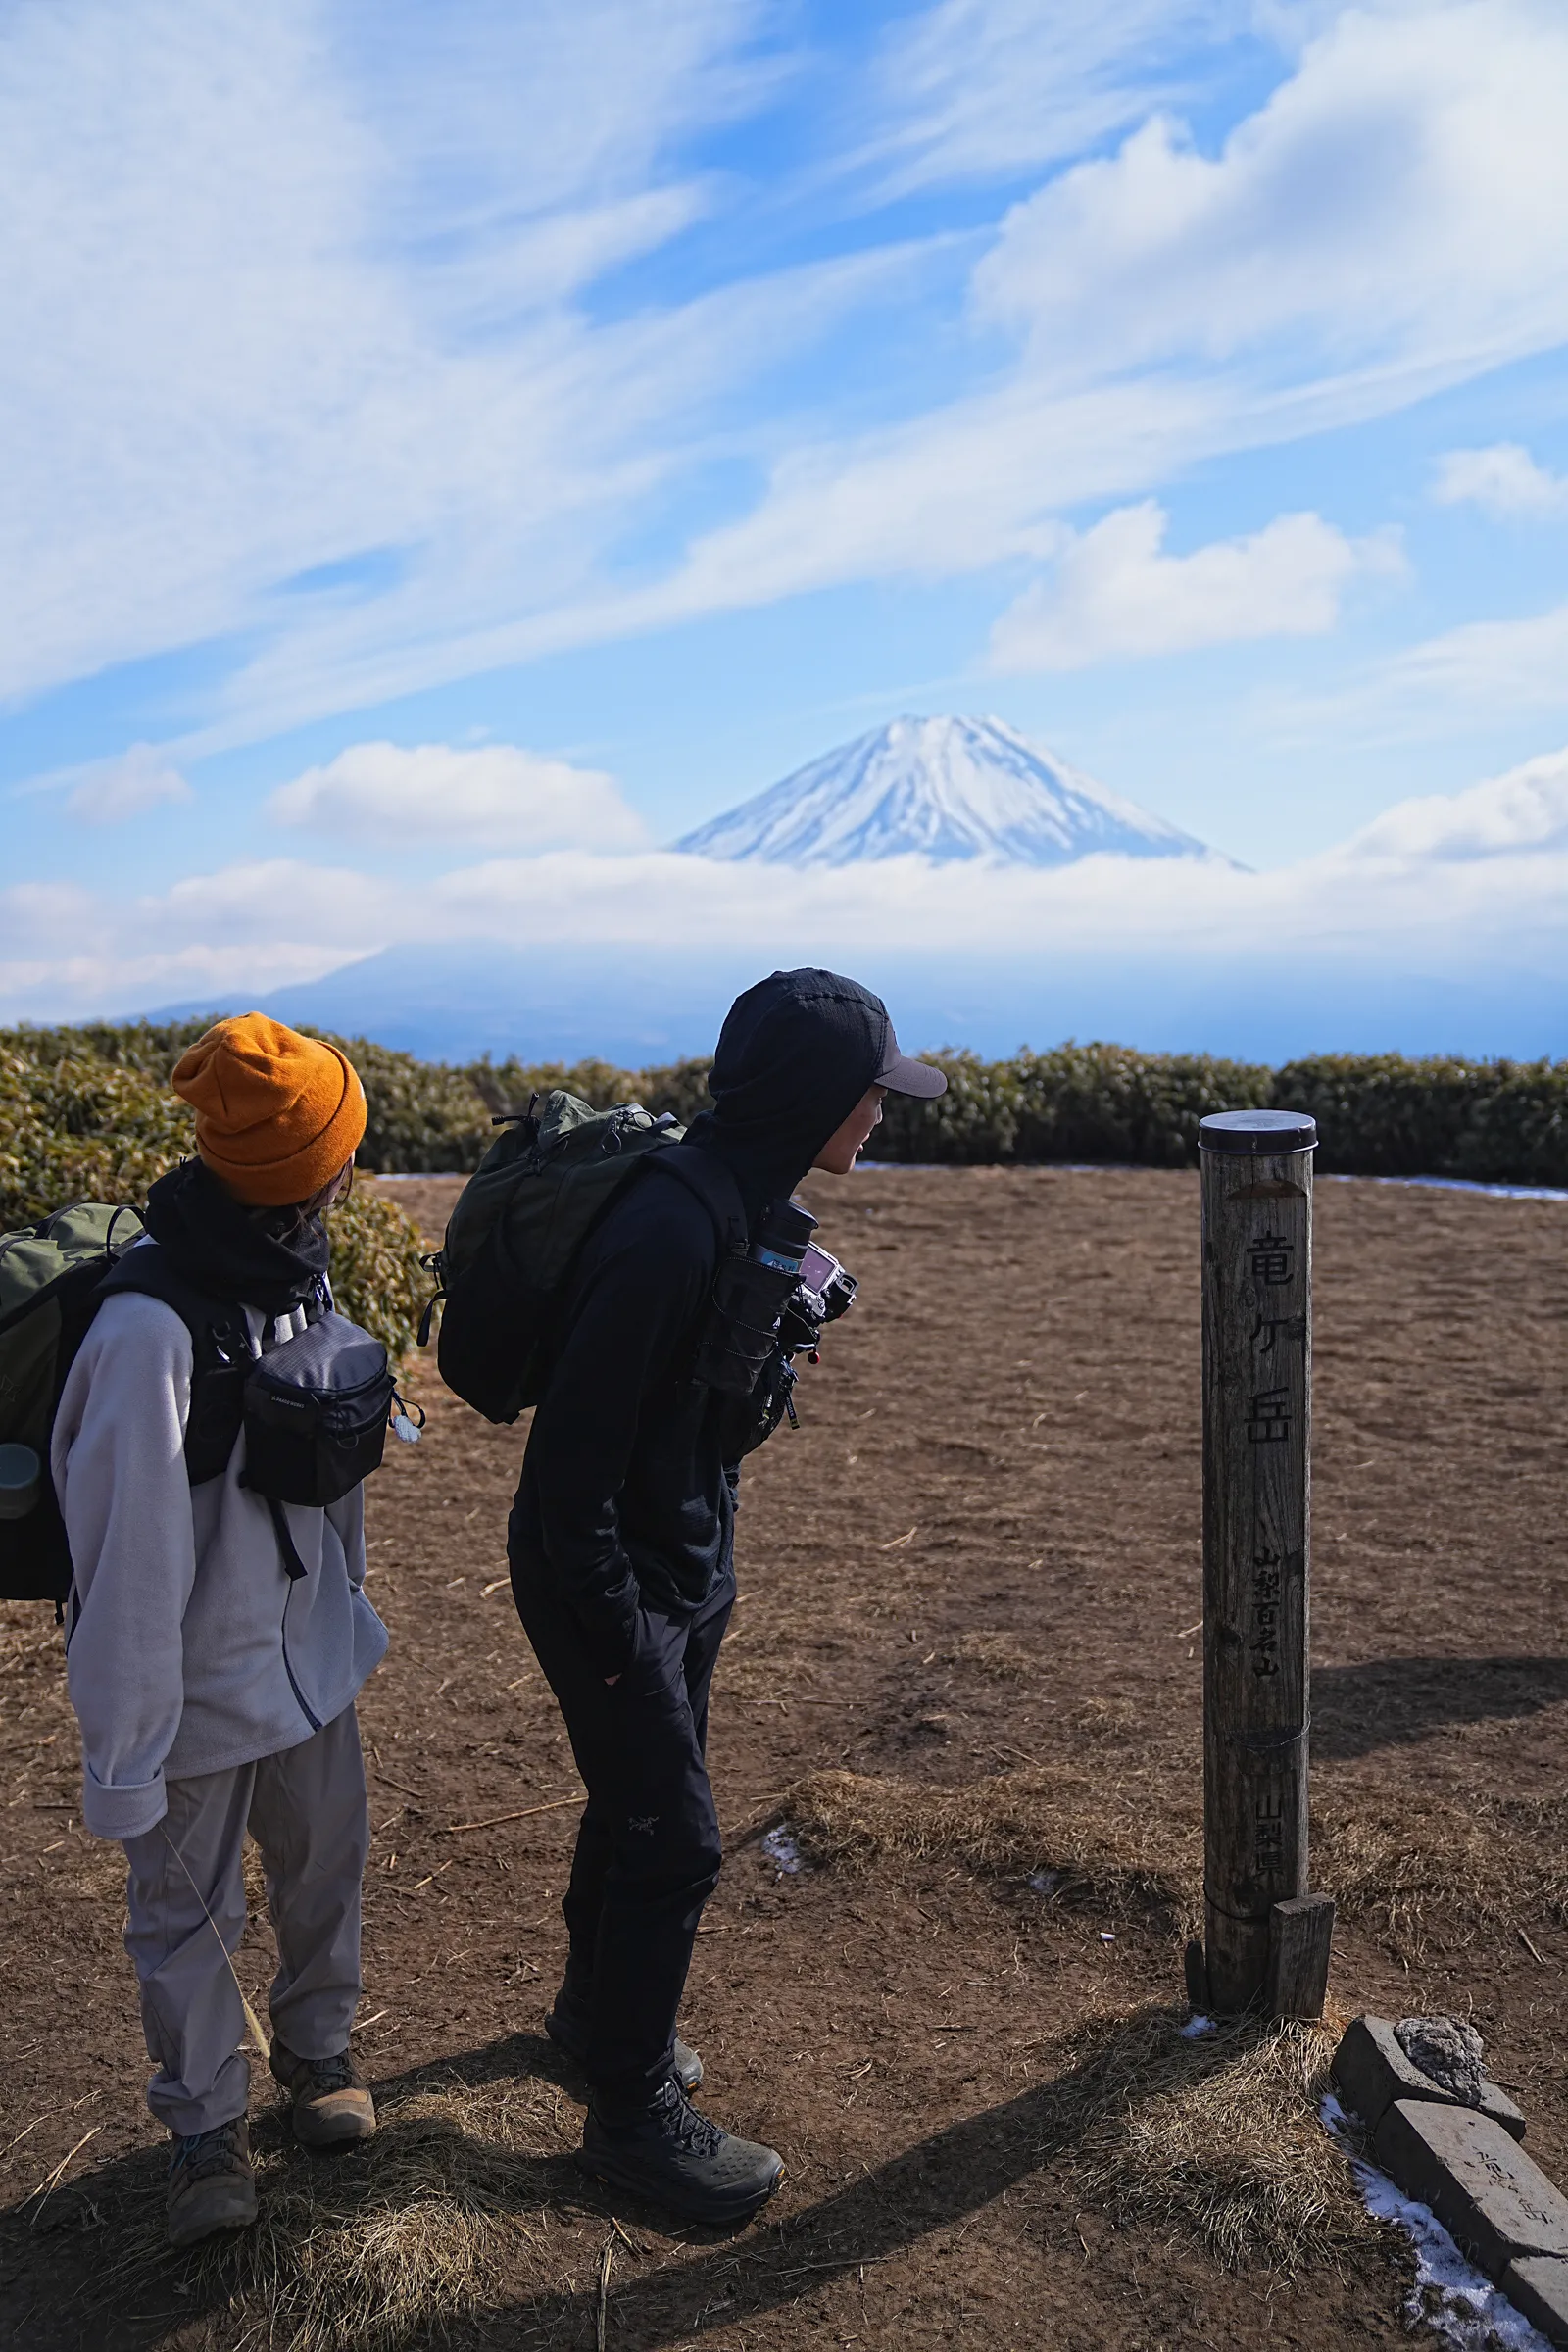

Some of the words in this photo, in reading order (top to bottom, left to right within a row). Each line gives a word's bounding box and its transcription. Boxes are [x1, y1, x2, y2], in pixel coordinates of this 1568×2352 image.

[1250, 1546, 1281, 1678] 山梨百名山
[1255, 1795, 1284, 1876] 山梨県
